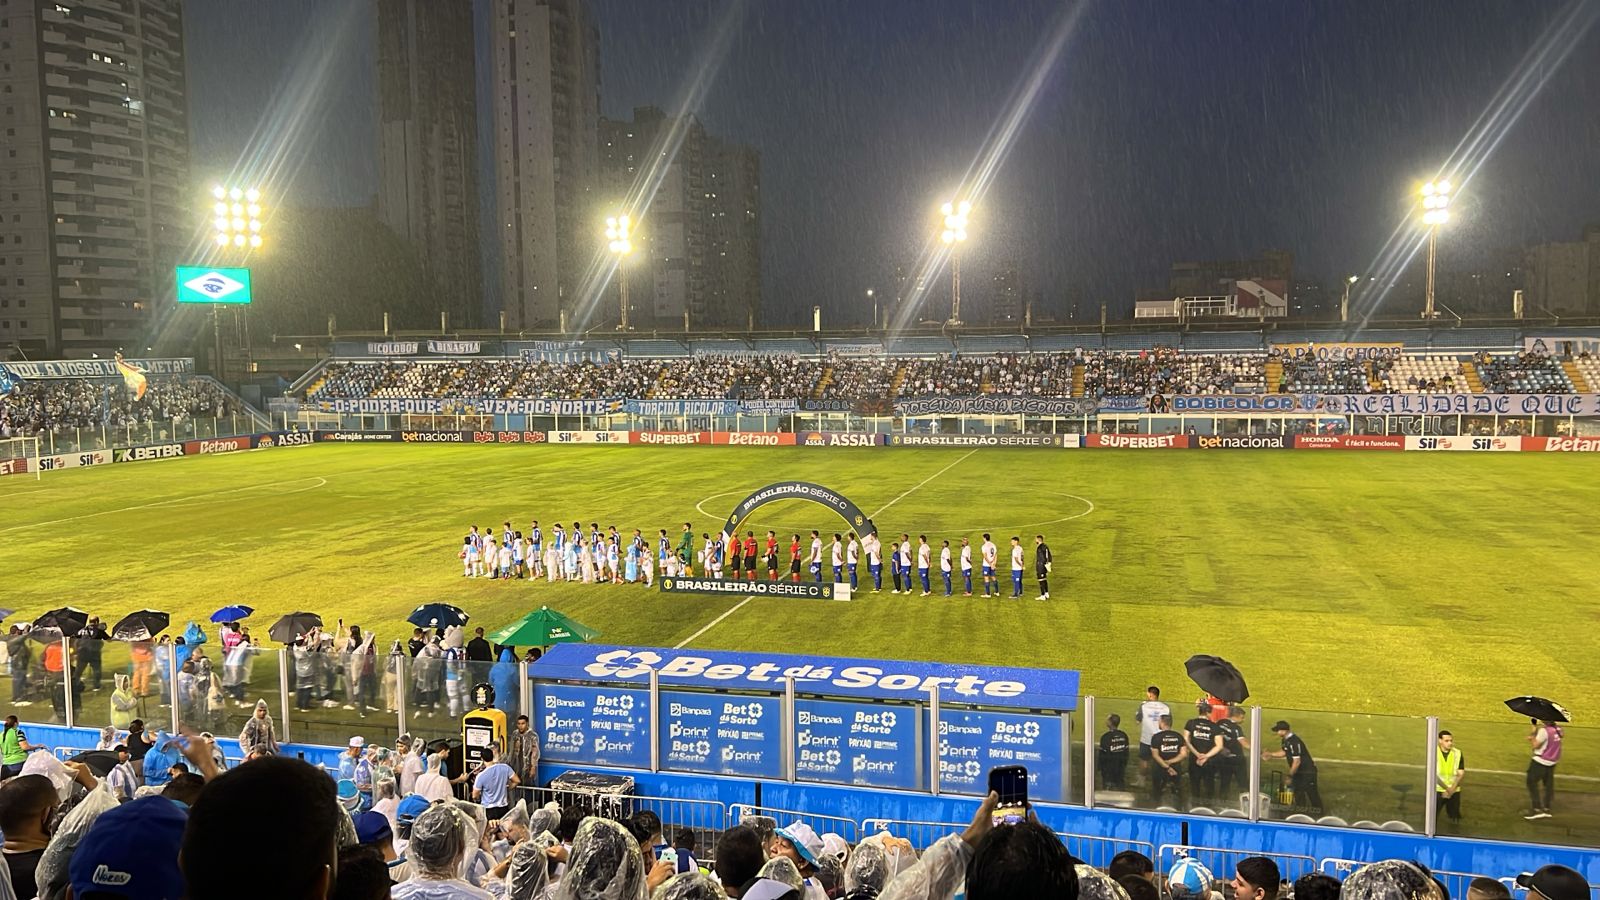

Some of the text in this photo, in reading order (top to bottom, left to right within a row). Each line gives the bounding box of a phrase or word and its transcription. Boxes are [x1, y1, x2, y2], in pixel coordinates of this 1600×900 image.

[45, 363, 58, 376] A
[57, 362, 104, 376] NOSSA
[146, 361, 185, 373] META!
[350, 400, 400, 412] PODER
[405, 400, 439, 412] QUE
[483, 400, 519, 413] VEM
[525, 400, 546, 413] DO
[550, 400, 605, 414] NORTE
[639, 401, 724, 415] TORCIDA BICOLOR
[901, 399, 962, 414] TORCIDA
[1011, 399, 1079, 414] BICOLOR
[1344, 394, 1583, 415] REALIDADE QUE
[334, 433, 362, 441] Carajás
[402, 431, 463, 442] betnacional
[474, 431, 494, 443] Bob's
[499, 431, 519, 443] Bob's
[524, 431, 544, 443] Bob's
[559, 433, 571, 442] Sil
[596, 433, 608, 442] Sil
[640, 432, 700, 445] SUPERBET
[728, 432, 778, 445] Betano
[904, 434, 1051, 445] BRASILEIRÃO SÉRIE C
[1100, 434, 1175, 448] SUPERBET
[1199, 435, 1284, 449] betnacional
[200, 440, 238, 454] Betano
[1419, 438, 1437, 449] Sil
[1472, 438, 1490, 449] Sil
[40, 458, 53, 470] Sil
[80, 454, 93, 466] Sil
[743, 484, 847, 510] BRASILEIRÃO SÉRIE C
[676, 579, 818, 596] BRASILEIRÃO SÉRIE C
[658, 656, 1027, 697] Bet dá Sorte
[596, 695, 619, 706] Bet
[603, 707, 629, 716] Sorte
[723, 703, 747, 715] Bet
[730, 716, 757, 725] Sorte
[855, 711, 879, 723] Bet
[558, 719, 582, 727] print
[996, 721, 1022, 733] Bet
[683, 727, 708, 736] print
[862, 724, 891, 734] Sorte
[548, 732, 569, 743] Bet
[812, 736, 838, 745] print
[1003, 734, 1034, 745] Sorte
[555, 744, 579, 752] Sorte
[608, 742, 632, 751] print
[672, 741, 695, 752] Bet
[949, 747, 978, 756] print
[679, 753, 705, 762] Sorte
[735, 751, 761, 760] print
[801, 750, 824, 761] Bet
[808, 762, 835, 772] Sorte
[867, 762, 894, 771] print
[940, 761, 963, 772] Bet
[945, 774, 974, 784] Sorte
